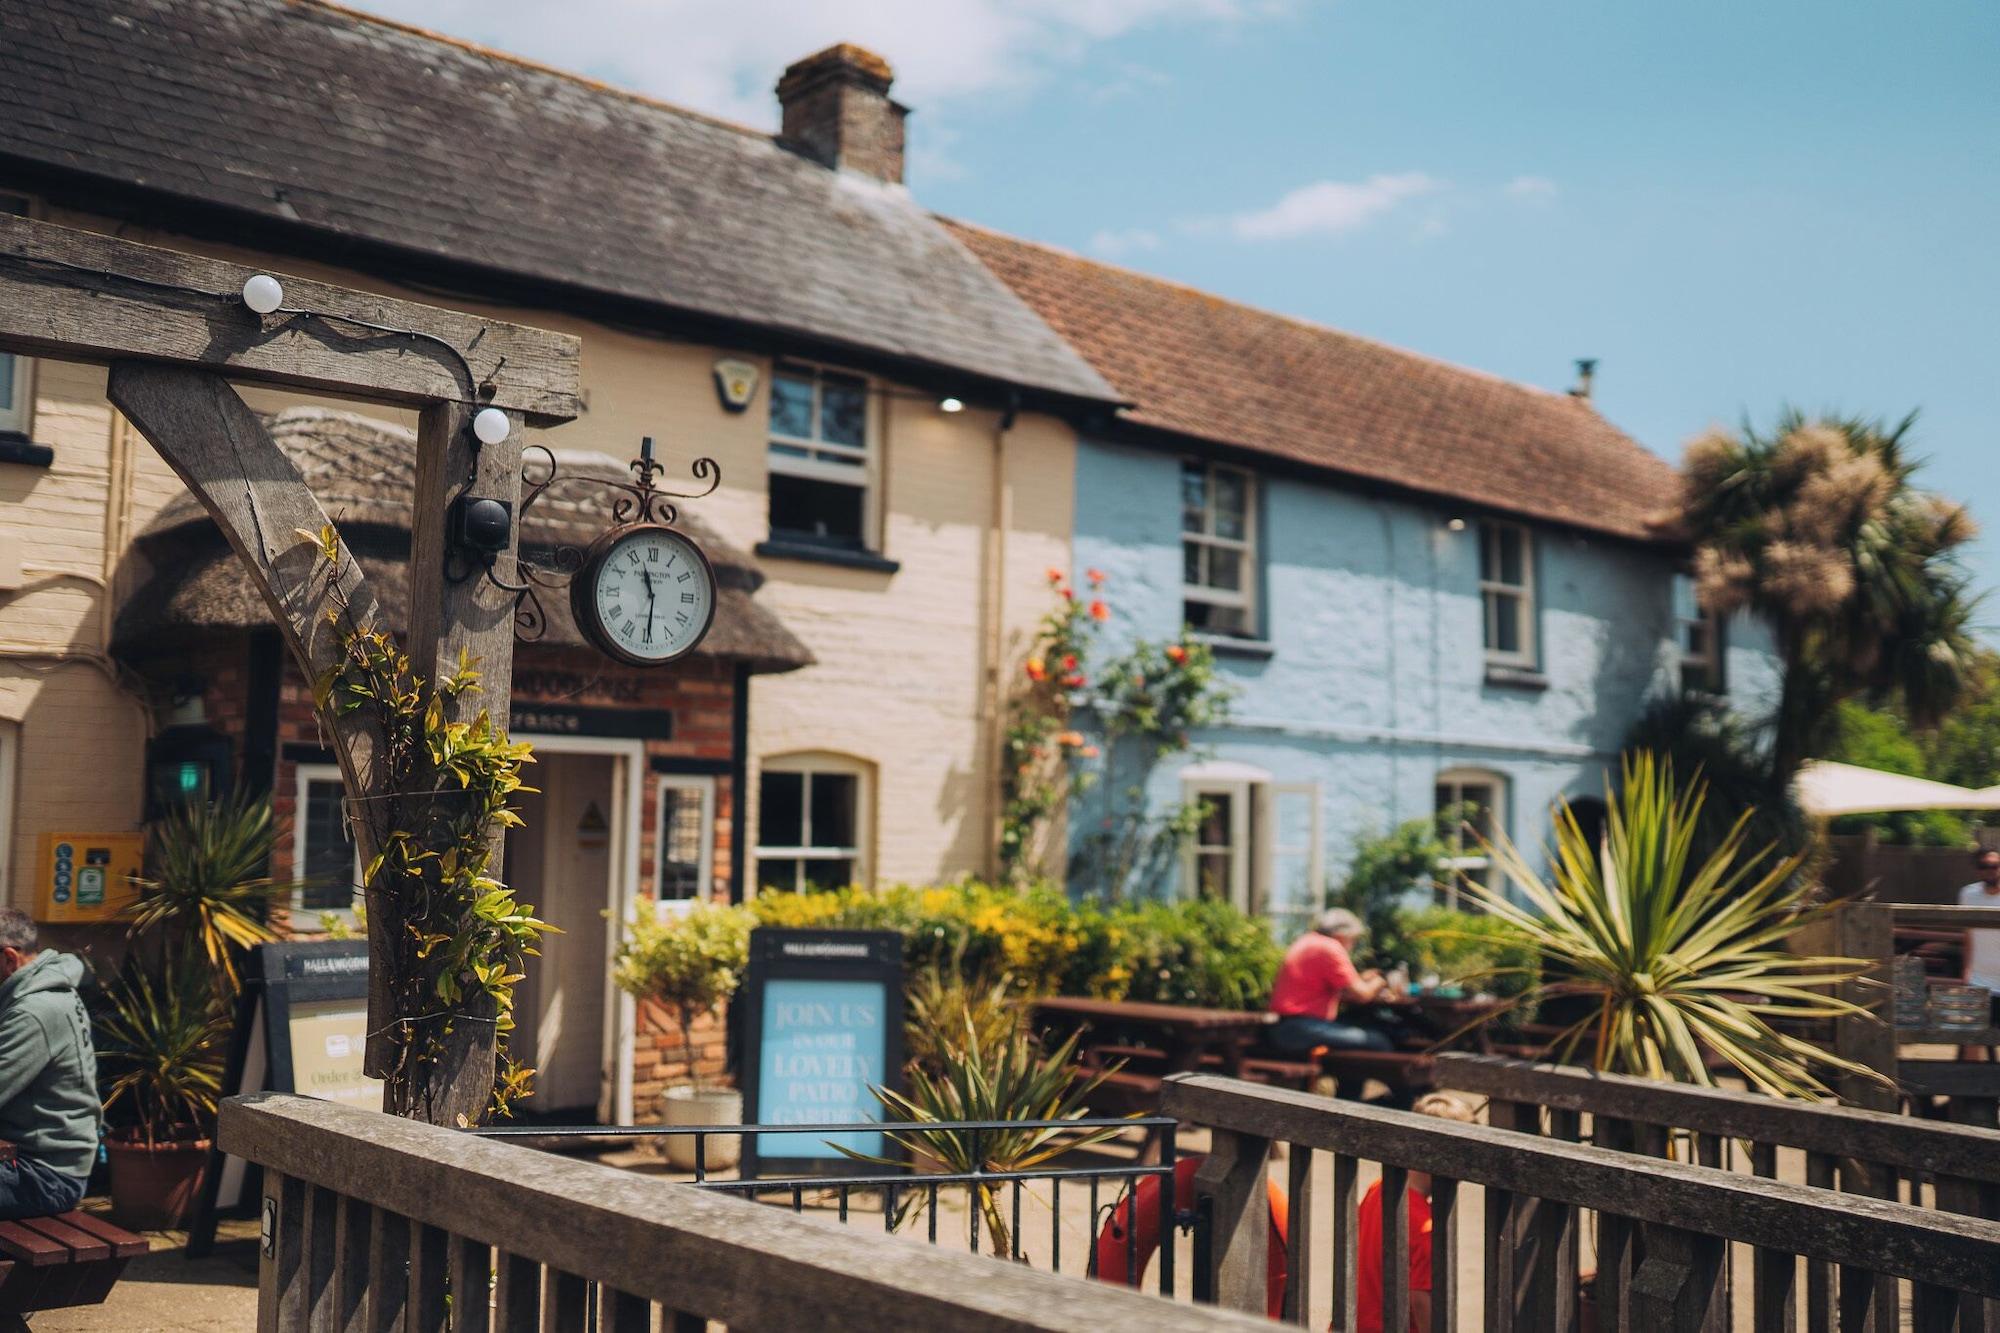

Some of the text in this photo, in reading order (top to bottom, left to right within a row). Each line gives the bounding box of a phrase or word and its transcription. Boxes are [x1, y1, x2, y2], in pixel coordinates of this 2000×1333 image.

[627, 550, 640, 566] XI
[647, 547, 659, 563] XII
[666, 554, 676, 568] I
[612, 564, 626, 579] X
[633, 570, 671, 579] PADINGTON
[677, 571, 691, 583] II
[606, 585, 620, 598] IX
[681, 592, 694, 604] III
[675, 611, 688, 627] IV
[621, 619, 636, 638] VII
[664, 626, 673, 640] V
[512, 712, 579, 730] rance
[776, 1002, 876, 1030] JOIN US
[774, 1054, 877, 1078] LOVELY
[788, 1081, 859, 1102] PATIO
